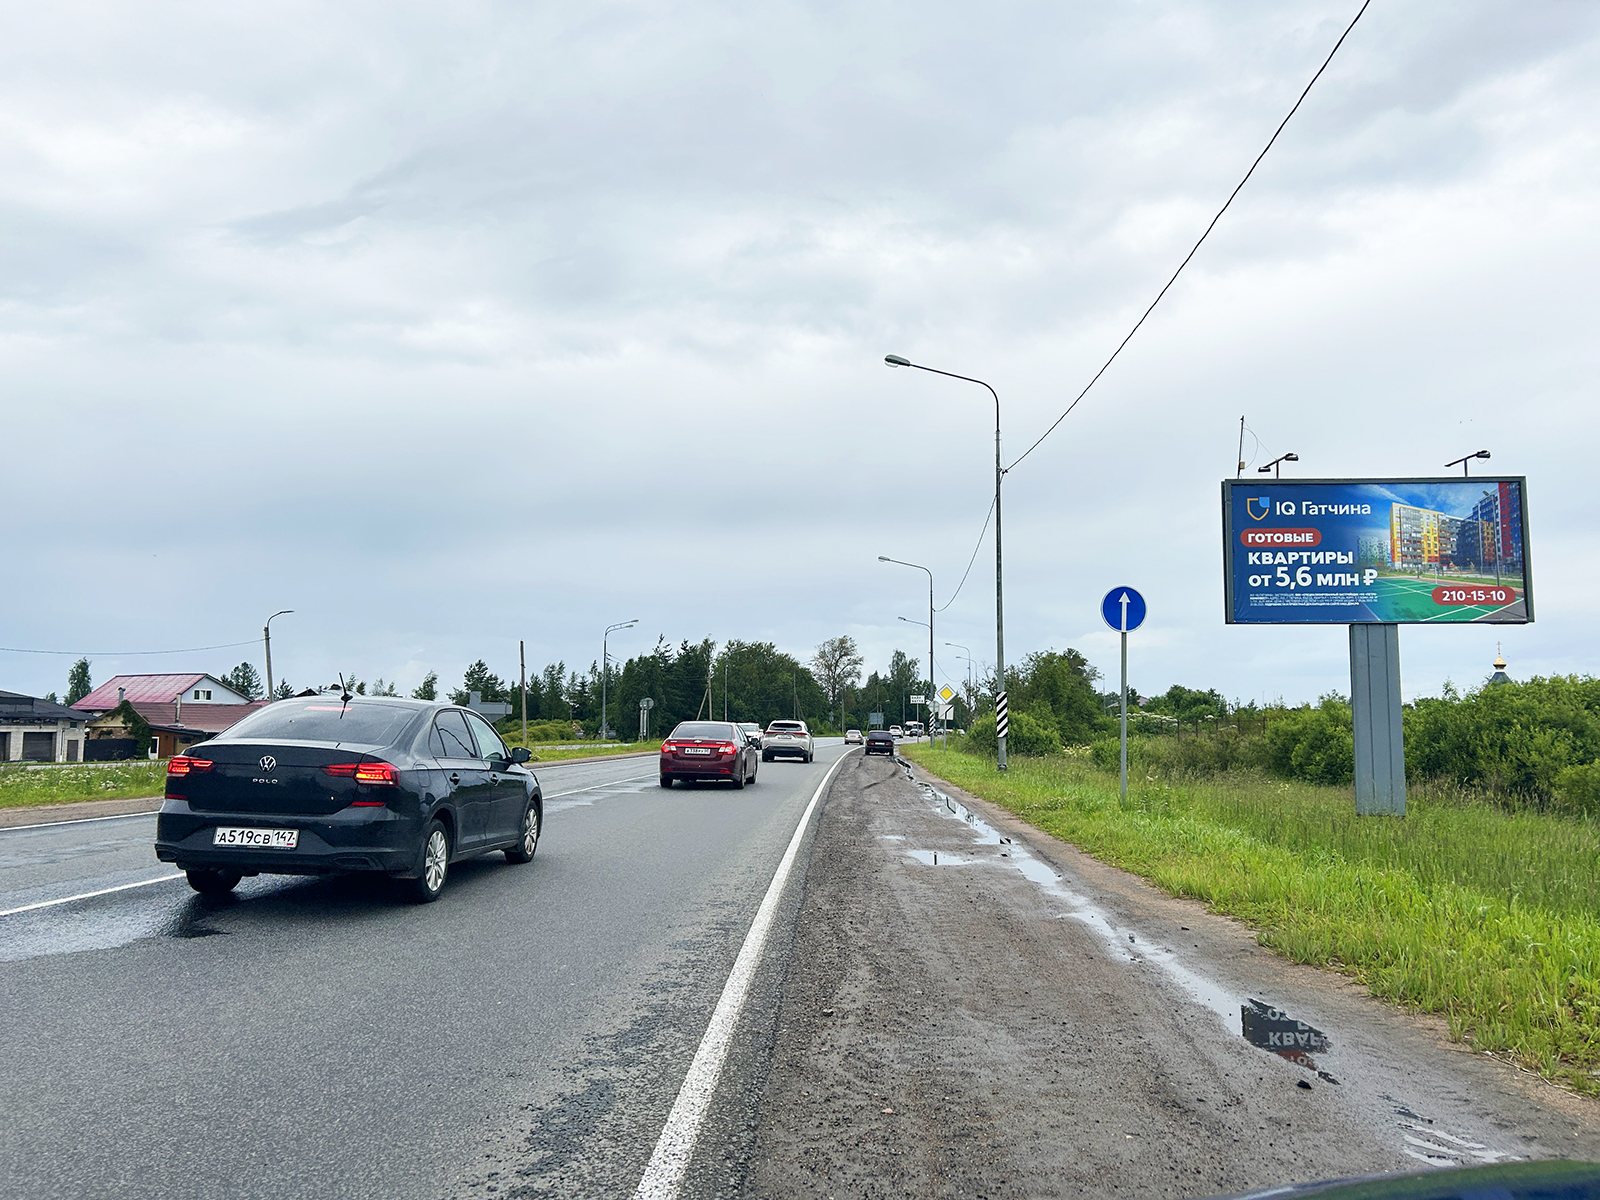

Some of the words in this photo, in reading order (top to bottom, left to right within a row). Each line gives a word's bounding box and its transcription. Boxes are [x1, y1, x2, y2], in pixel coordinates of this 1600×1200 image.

[1276, 501, 1296, 516] IQ
[1301, 501, 1371, 516] Гатчина
[1248, 533, 1314, 543] ГОТОВЫЕ
[1248, 551, 1353, 565] КВАРТИРЫ
[1276, 566, 1312, 590] 5,6
[1442, 590, 1506, 601] 210-15-10
[274, 831, 294, 842] 147
